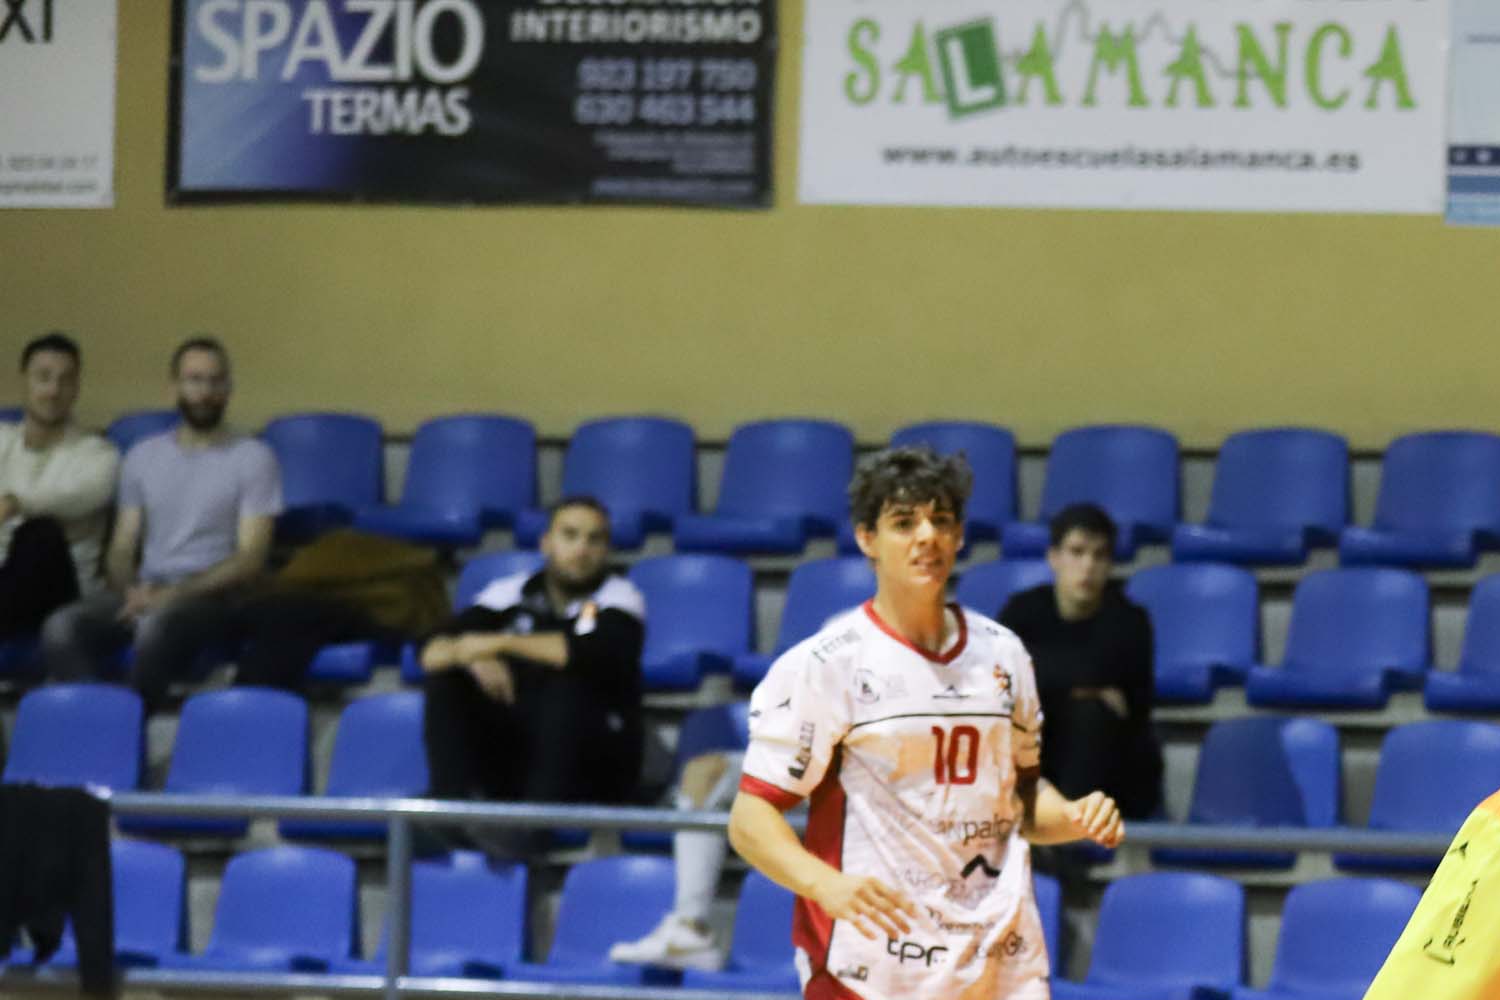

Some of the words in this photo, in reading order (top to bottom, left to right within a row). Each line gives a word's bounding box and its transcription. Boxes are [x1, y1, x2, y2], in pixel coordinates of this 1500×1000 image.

[195, 0, 484, 84] SPAZIO
[509, 8, 762, 44] INTERIORISMO
[843, 17, 1418, 109] SALAMANCA
[301, 87, 473, 136] TERMAS
[882, 144, 1361, 171] www.autoescuelasalamanca.es
[931, 725, 980, 785] 10
